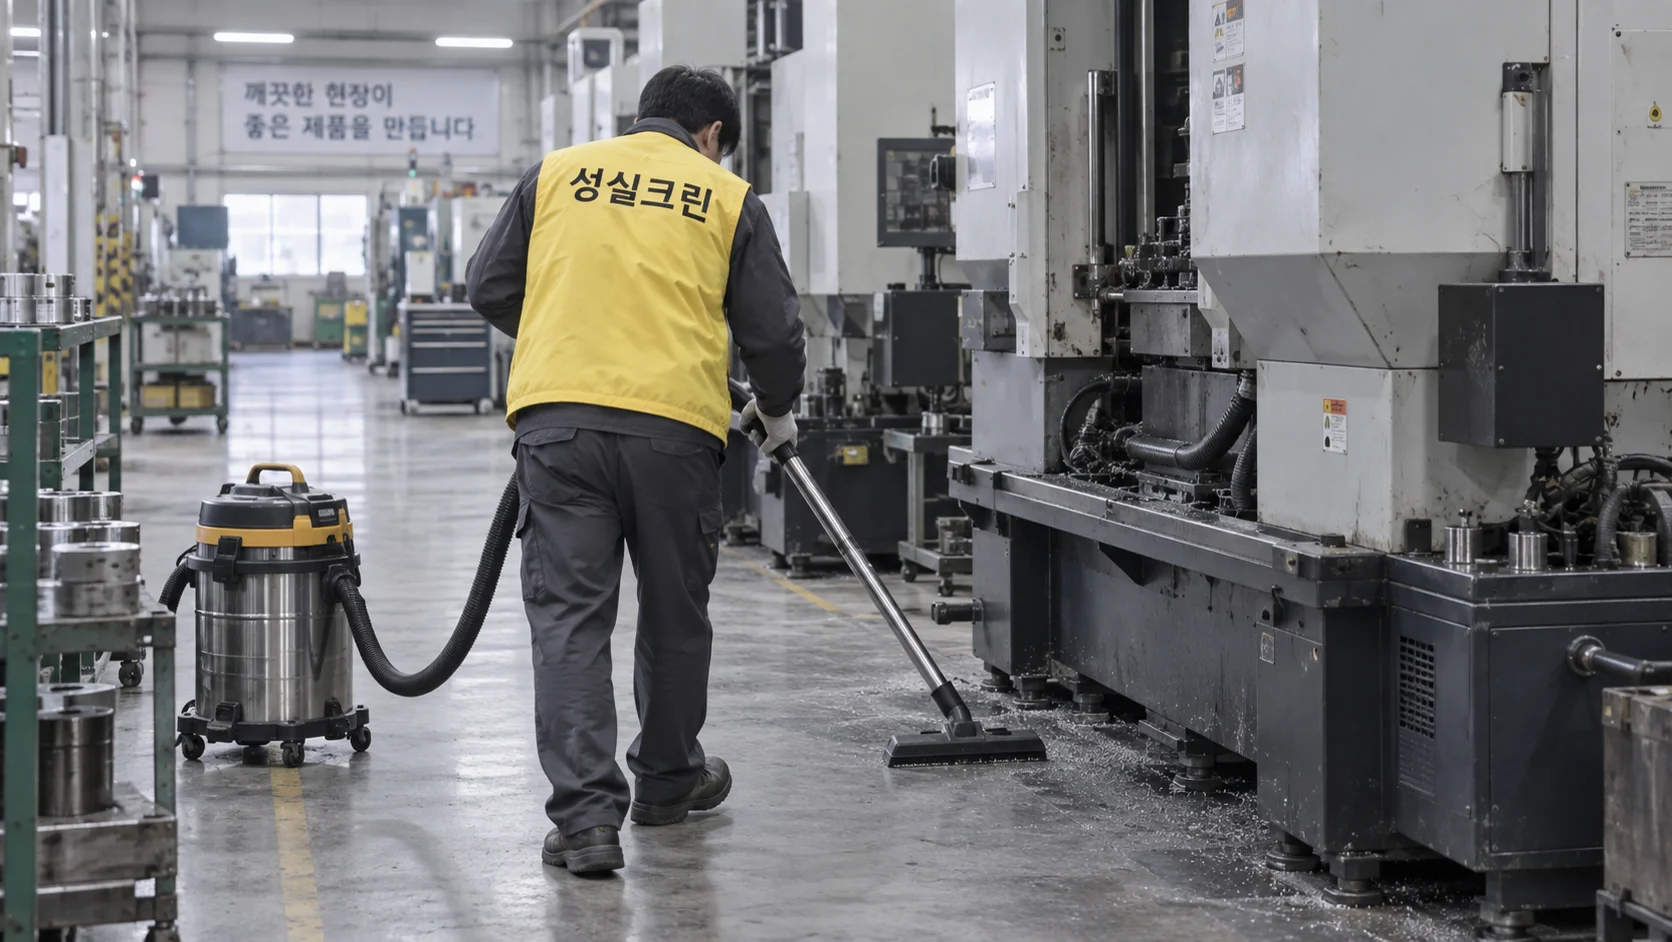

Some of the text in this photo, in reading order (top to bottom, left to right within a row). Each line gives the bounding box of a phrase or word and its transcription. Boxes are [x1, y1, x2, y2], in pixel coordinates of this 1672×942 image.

[244, 81, 393, 107] 깨끗한 현장이
[244, 114, 474, 141] 좋은 제품을 만듭니다
[569, 167, 712, 224] 성실크린
